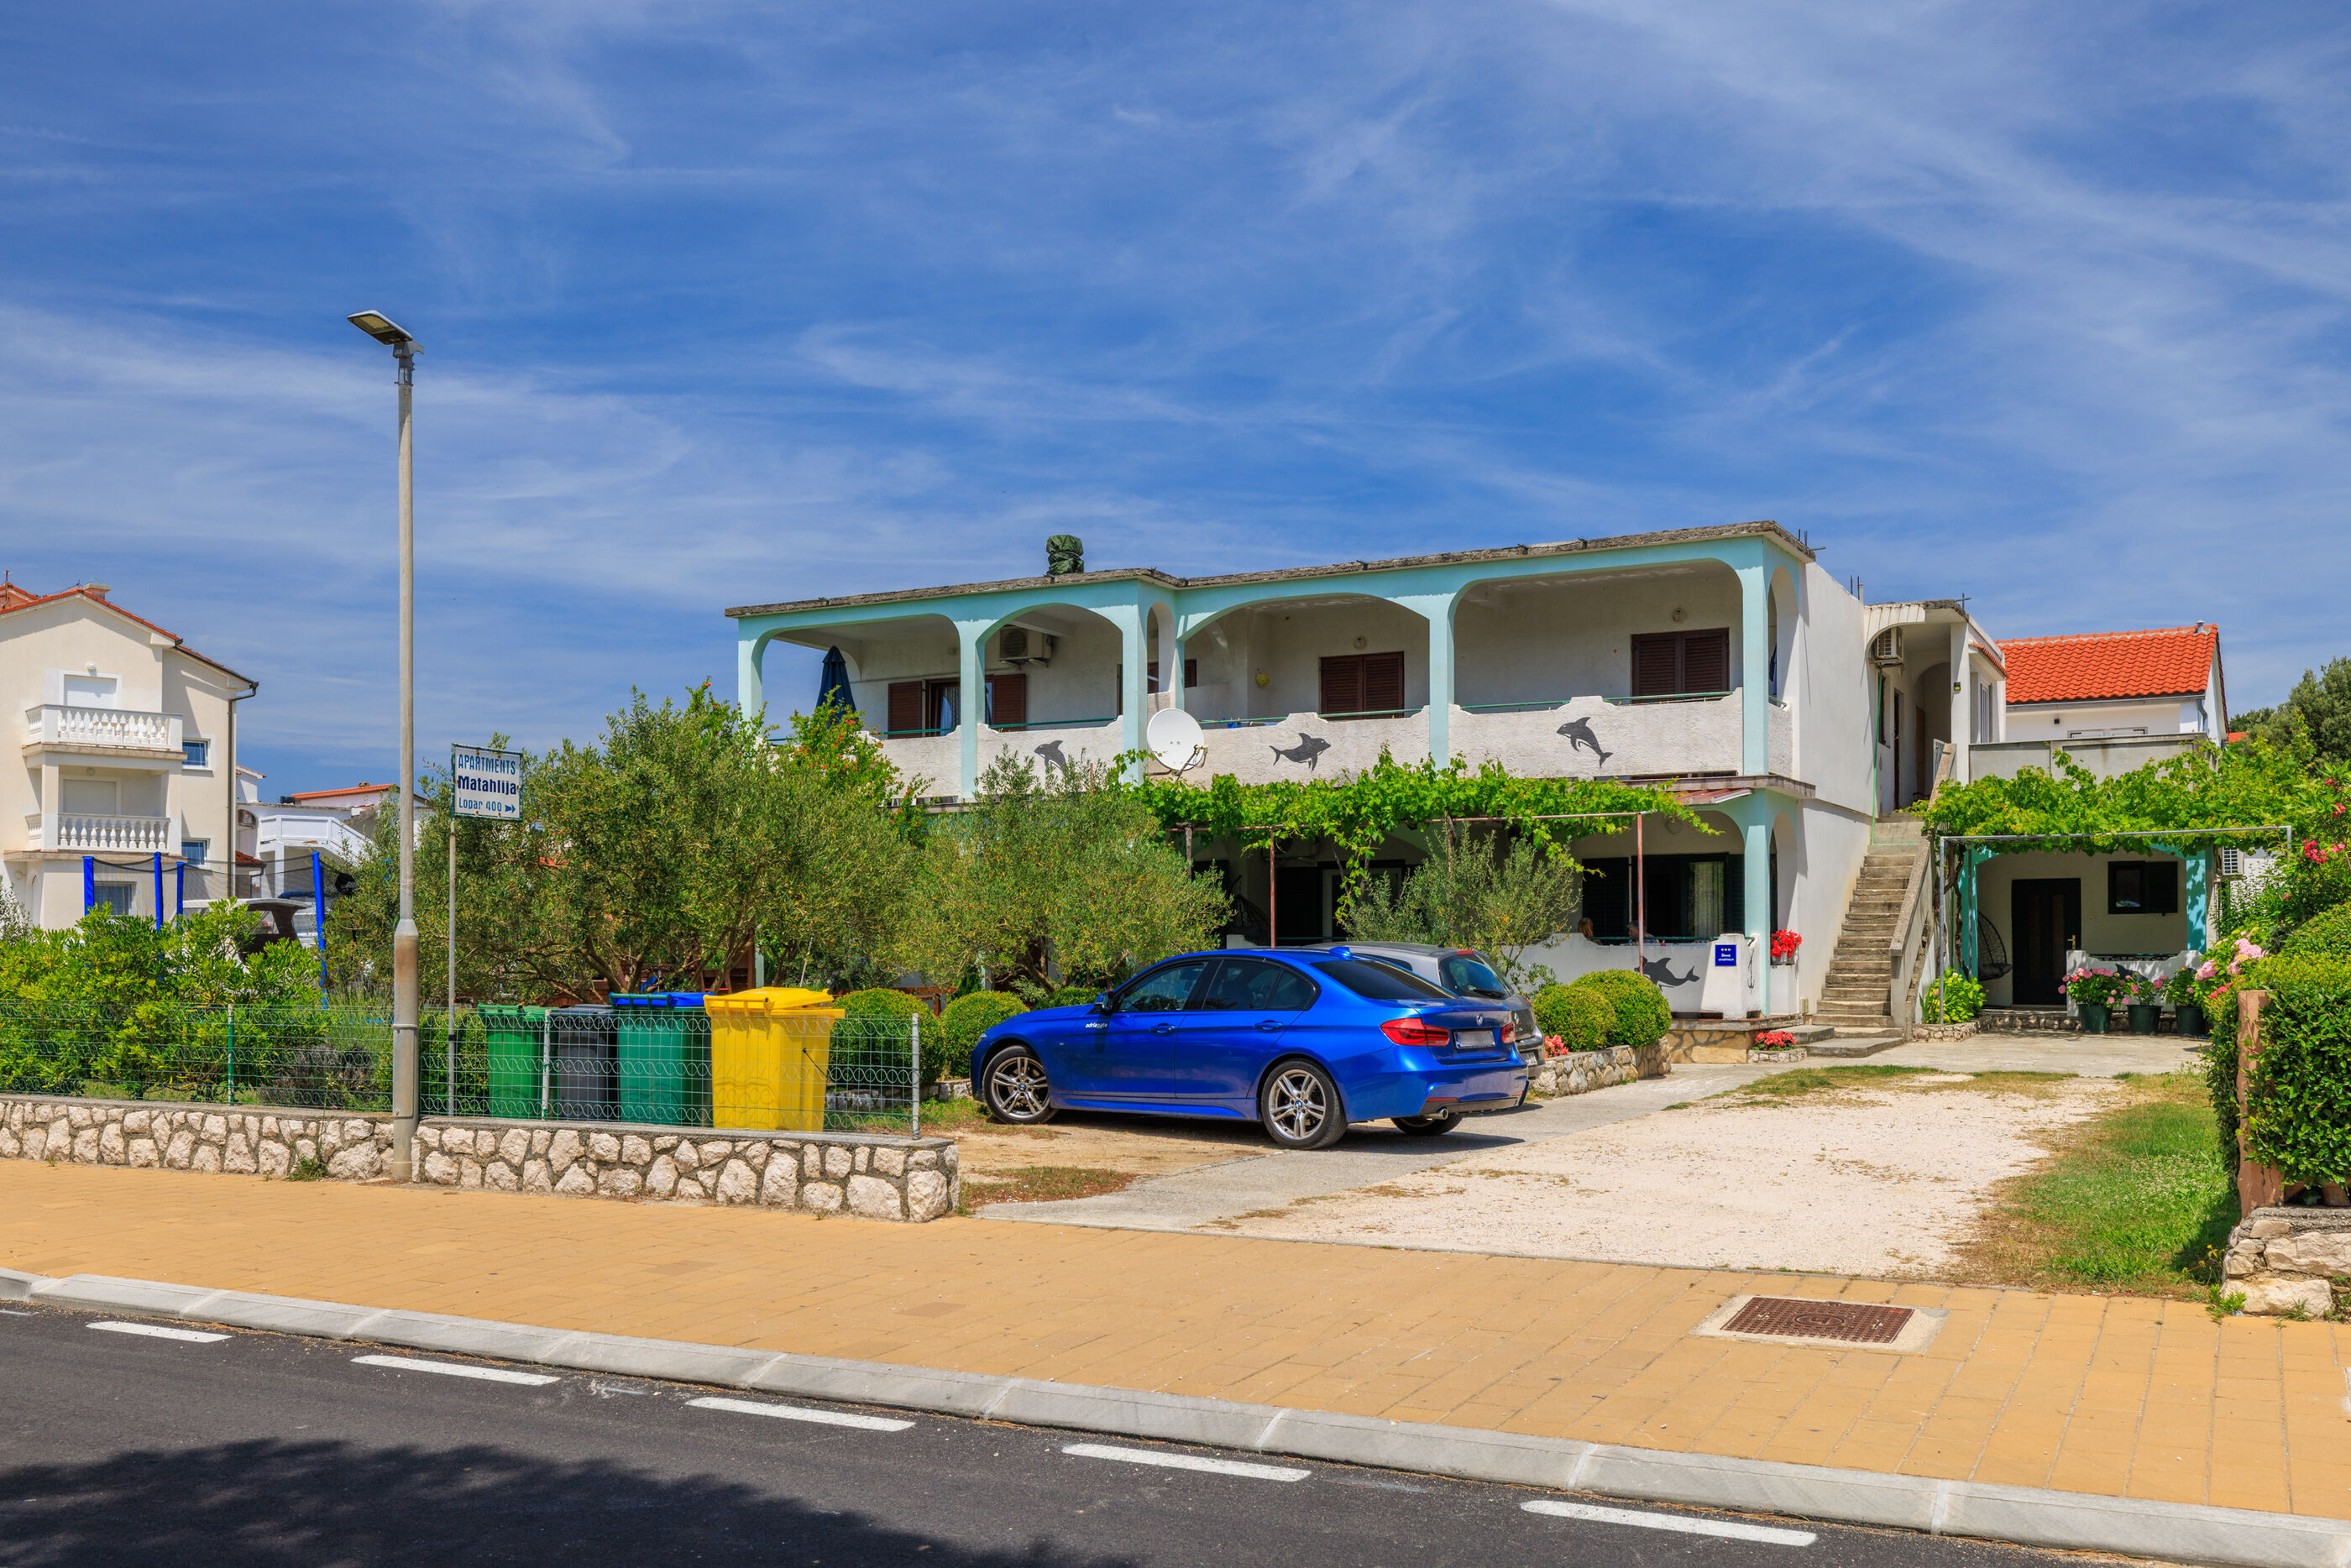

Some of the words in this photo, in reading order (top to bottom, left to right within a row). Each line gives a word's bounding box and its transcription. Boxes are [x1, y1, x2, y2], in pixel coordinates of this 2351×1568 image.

[458, 754, 516, 775] APARTMENTS
[458, 776, 516, 795] Matahlija
[485, 801, 502, 812] 400
